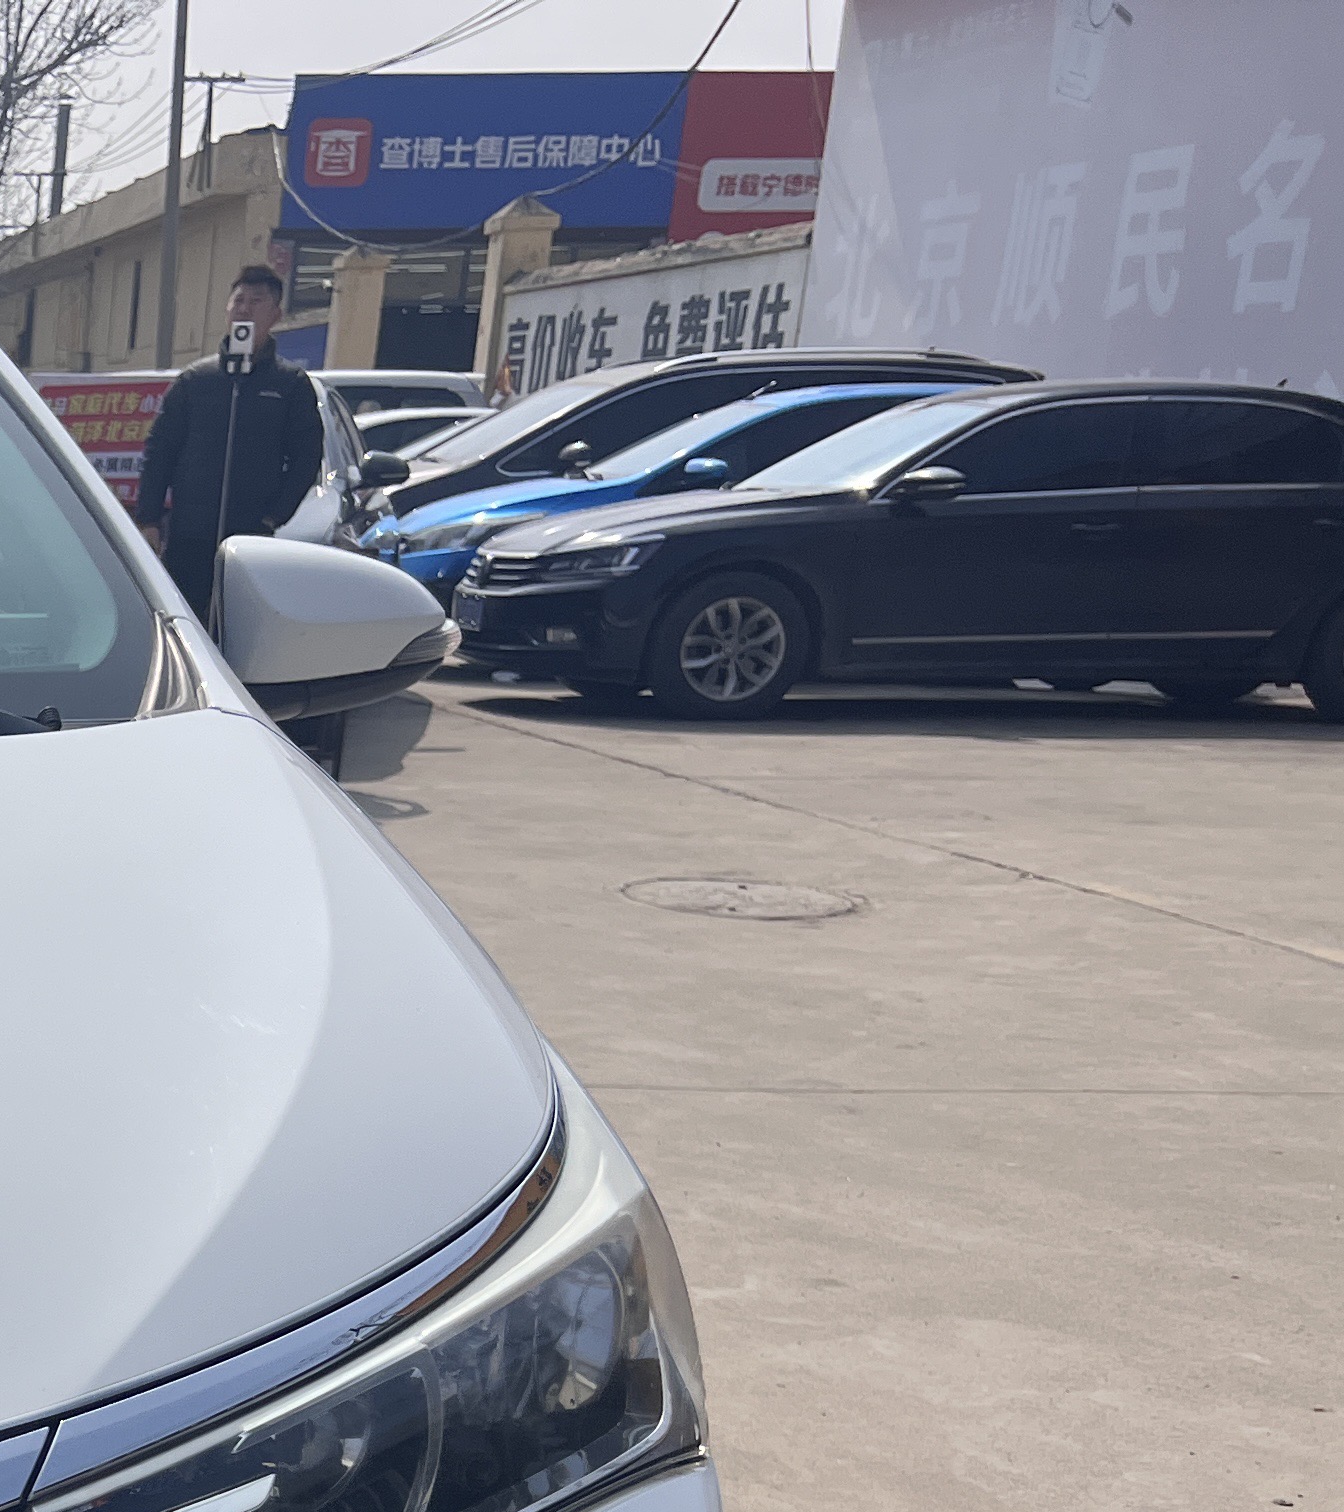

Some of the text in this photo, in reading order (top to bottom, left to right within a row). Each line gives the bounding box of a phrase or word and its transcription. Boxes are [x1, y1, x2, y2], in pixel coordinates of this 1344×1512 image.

[379, 134, 662, 170] 查博士售后保障中心
[507, 281, 792, 395] 高价收车 免费评估
